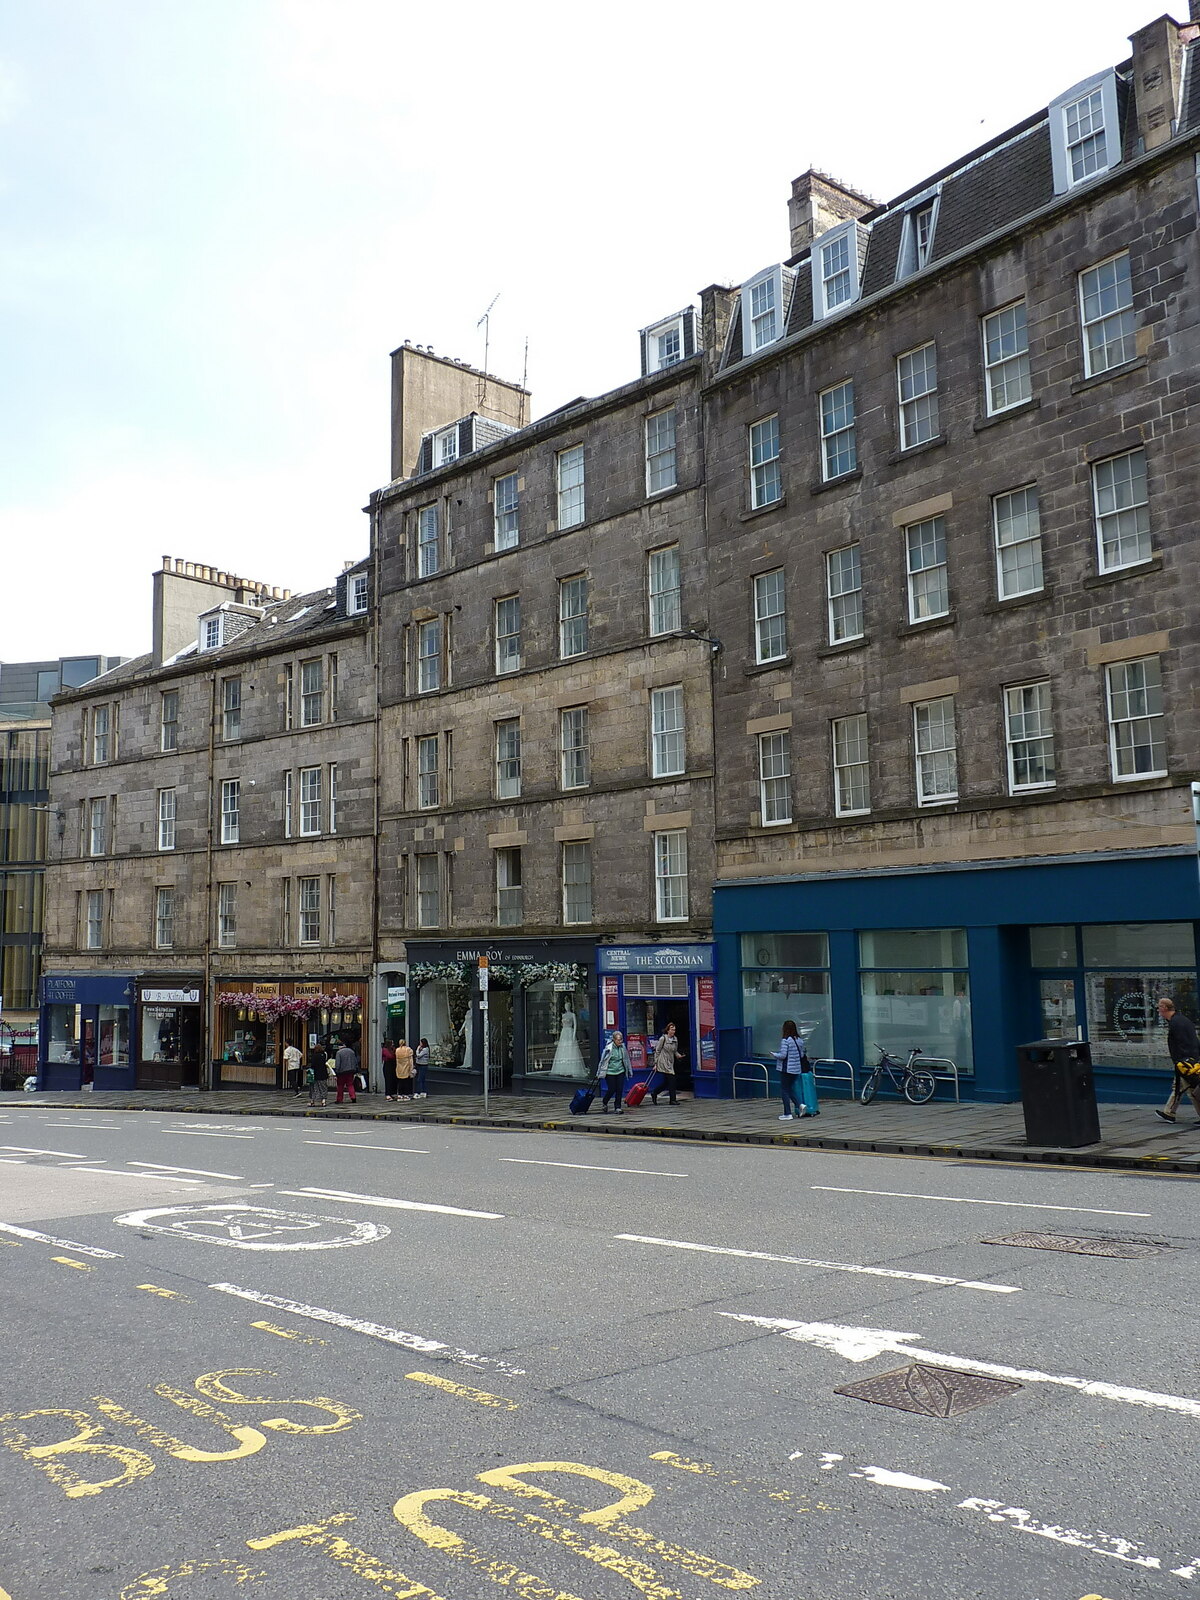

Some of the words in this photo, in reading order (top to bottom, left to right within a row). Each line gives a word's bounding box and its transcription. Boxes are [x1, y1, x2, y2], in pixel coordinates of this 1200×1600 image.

[456, 950, 482, 961] EMMA
[486, 950, 503, 961] ROY
[635, 956, 653, 965] THE
[655, 955, 703, 965] SCOTSMAN
[47, 979, 76, 988] PLATFORM
[255, 986, 277, 994] RAMEN
[295, 986, 320, 995] RAMEN
[55, 991, 76, 1000] COFFEE
[0, 1366, 364, 1499] BUS
